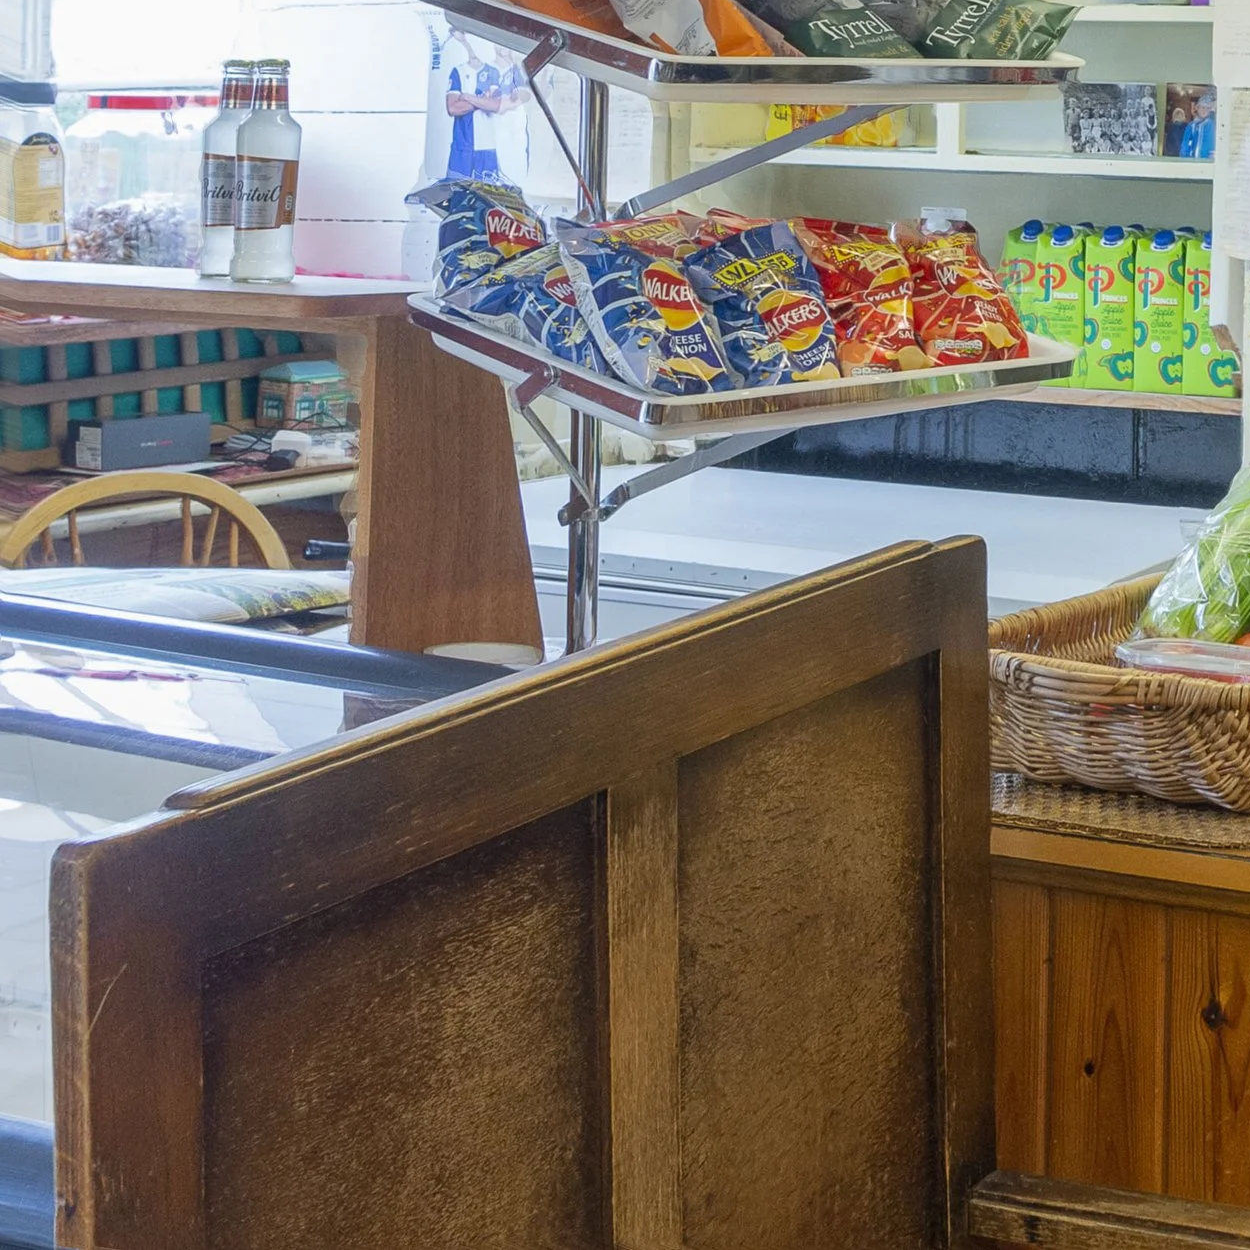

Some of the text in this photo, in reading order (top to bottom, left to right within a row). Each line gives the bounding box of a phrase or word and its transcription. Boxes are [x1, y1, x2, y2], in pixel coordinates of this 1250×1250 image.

[808, 10, 897, 48] Tyrrell
[432, 52, 441, 71] TOM
[629, 222, 670, 239] ONLY
[767, 301, 821, 338] ALKERS
